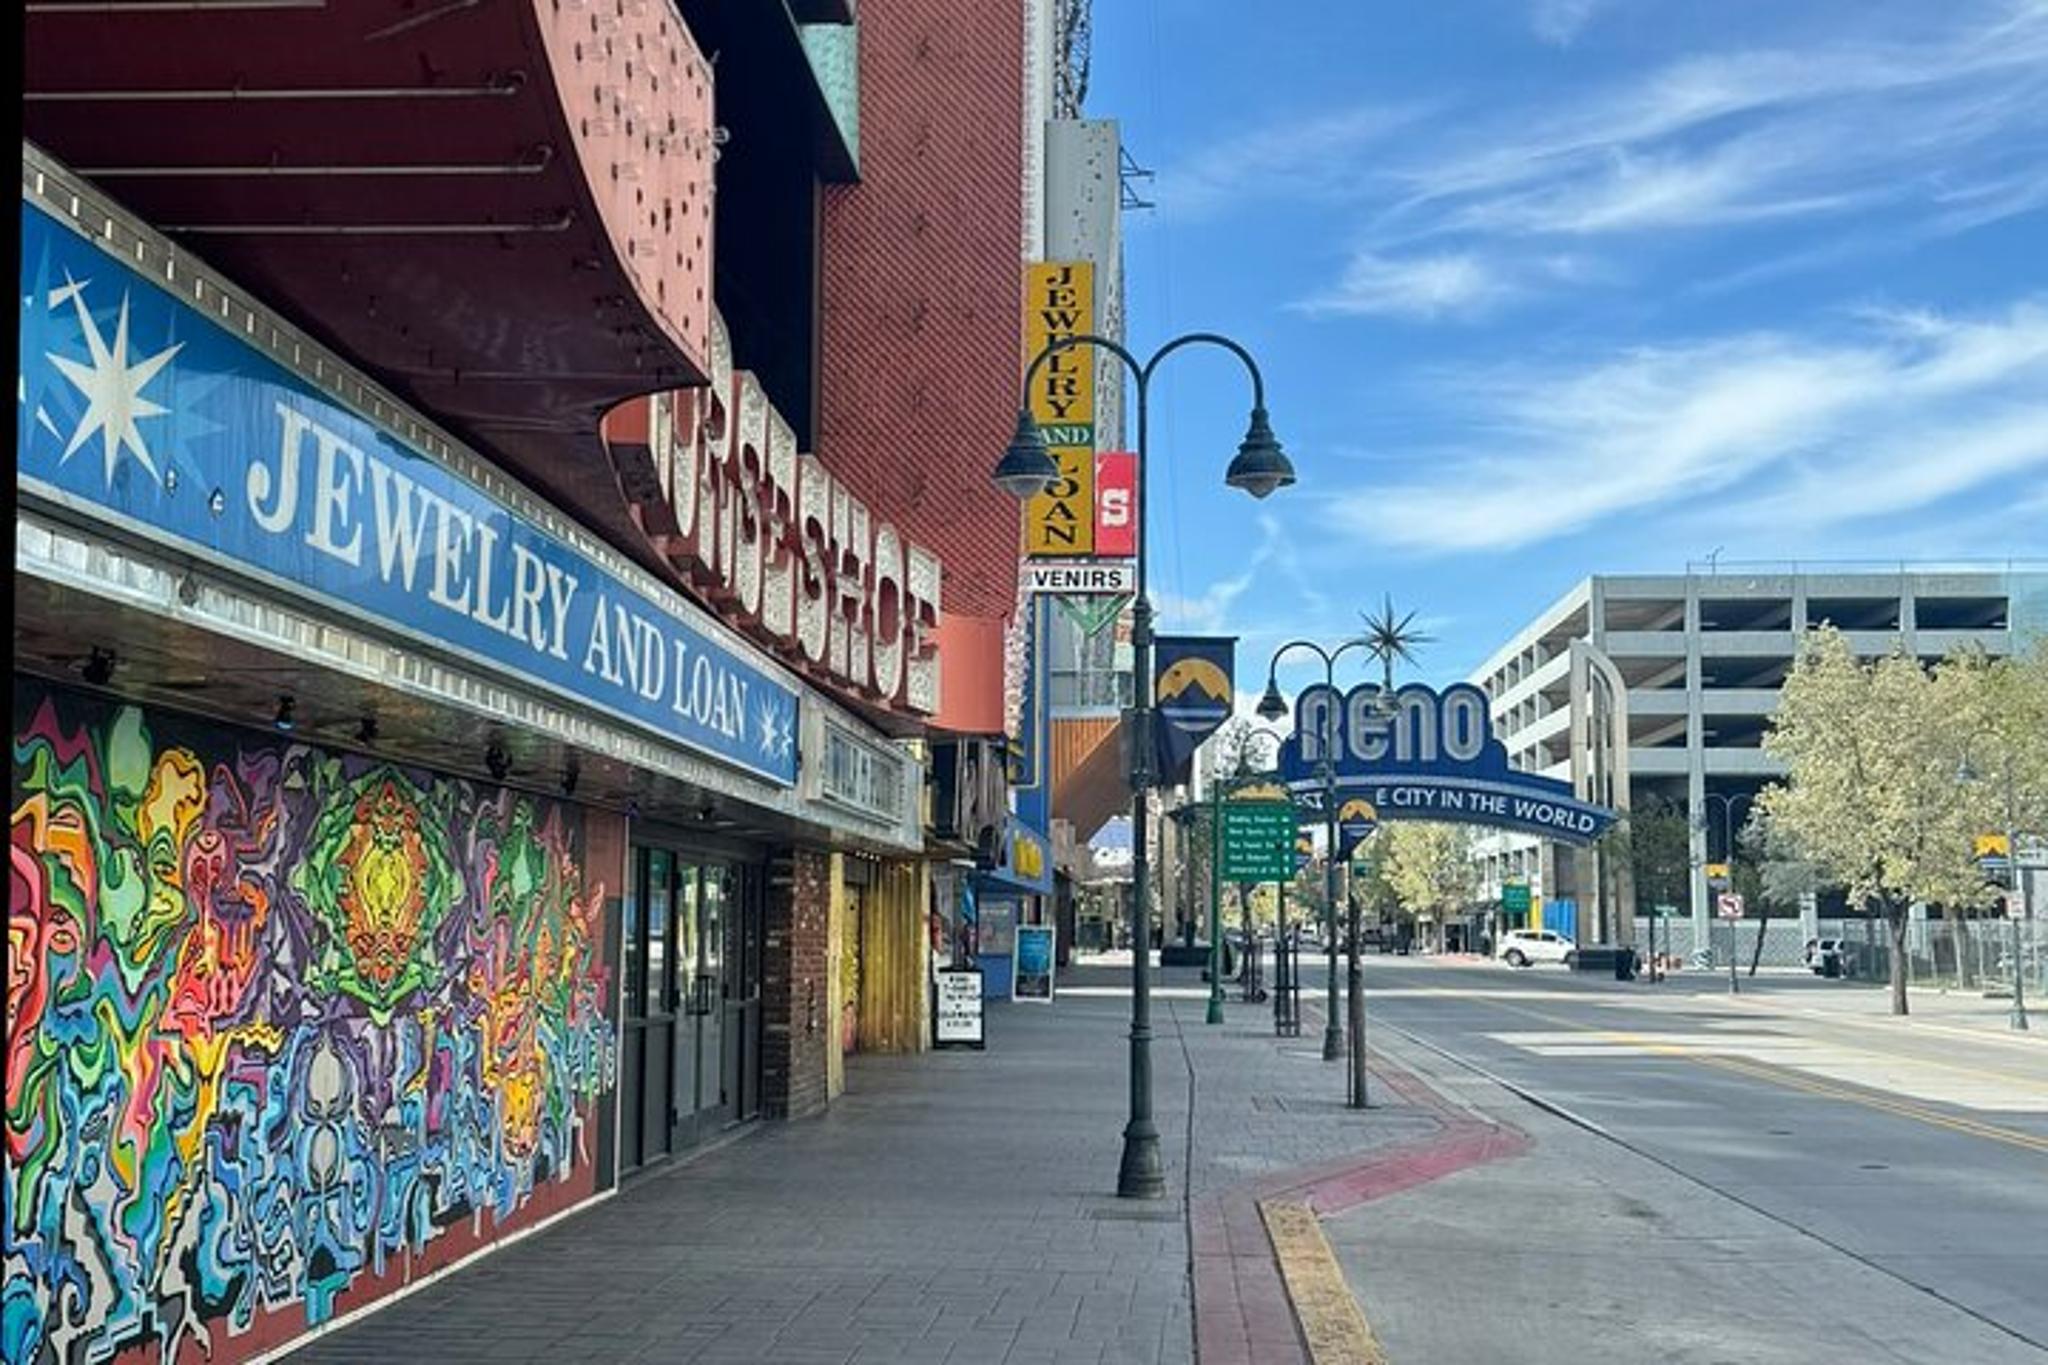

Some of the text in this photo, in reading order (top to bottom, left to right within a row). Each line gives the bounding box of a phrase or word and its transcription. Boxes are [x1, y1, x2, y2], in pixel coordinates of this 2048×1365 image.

[246, 401, 747, 742] JEWELRY AND LOAN
[1393, 787, 1436, 806] CITY
[1441, 790, 1463, 809] IN
[1468, 793, 1507, 814] THE
[1514, 798, 1595, 833] WORLD
